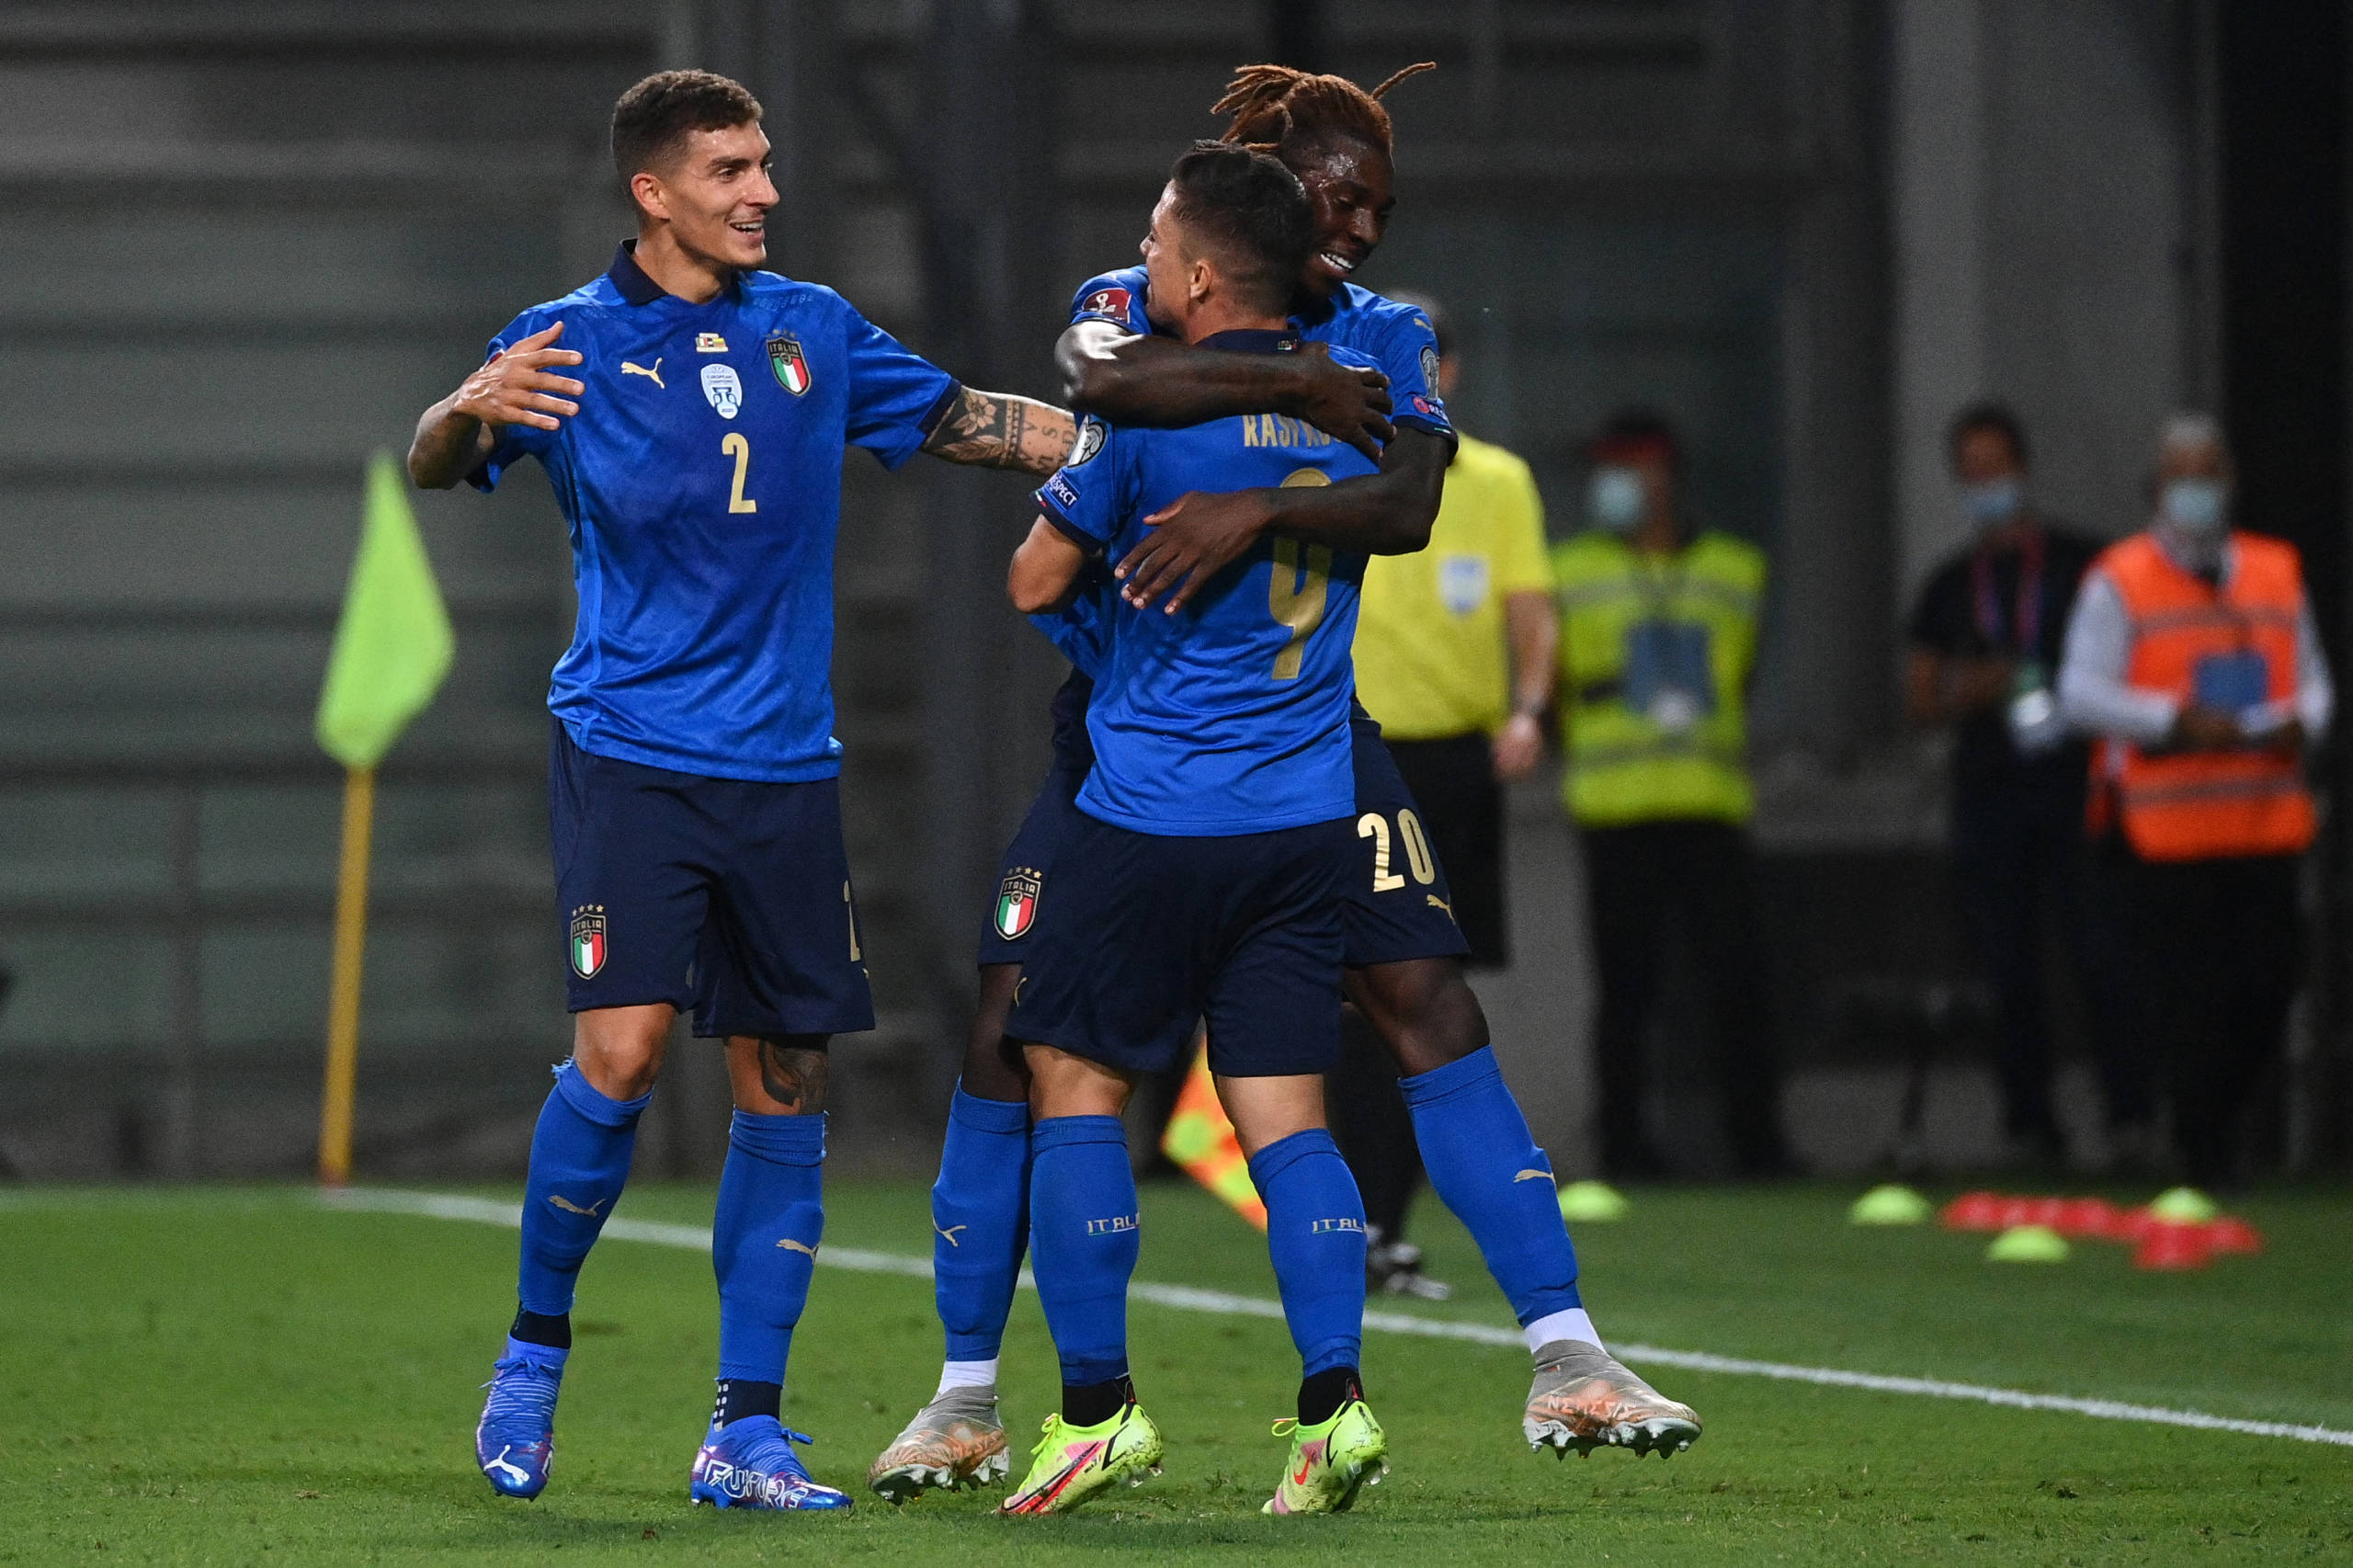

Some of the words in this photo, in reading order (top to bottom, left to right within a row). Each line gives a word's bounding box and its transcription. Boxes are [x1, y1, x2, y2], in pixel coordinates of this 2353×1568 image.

[769, 343, 799, 354] ITALIA
[722, 432, 756, 514] 2
[1268, 467, 1332, 680] 9
[1358, 808, 1436, 892] 20
[1004, 881, 1036, 893] ITALIA
[573, 919, 602, 934] ITALIA
[704, 1459, 809, 1509] FUTURE
